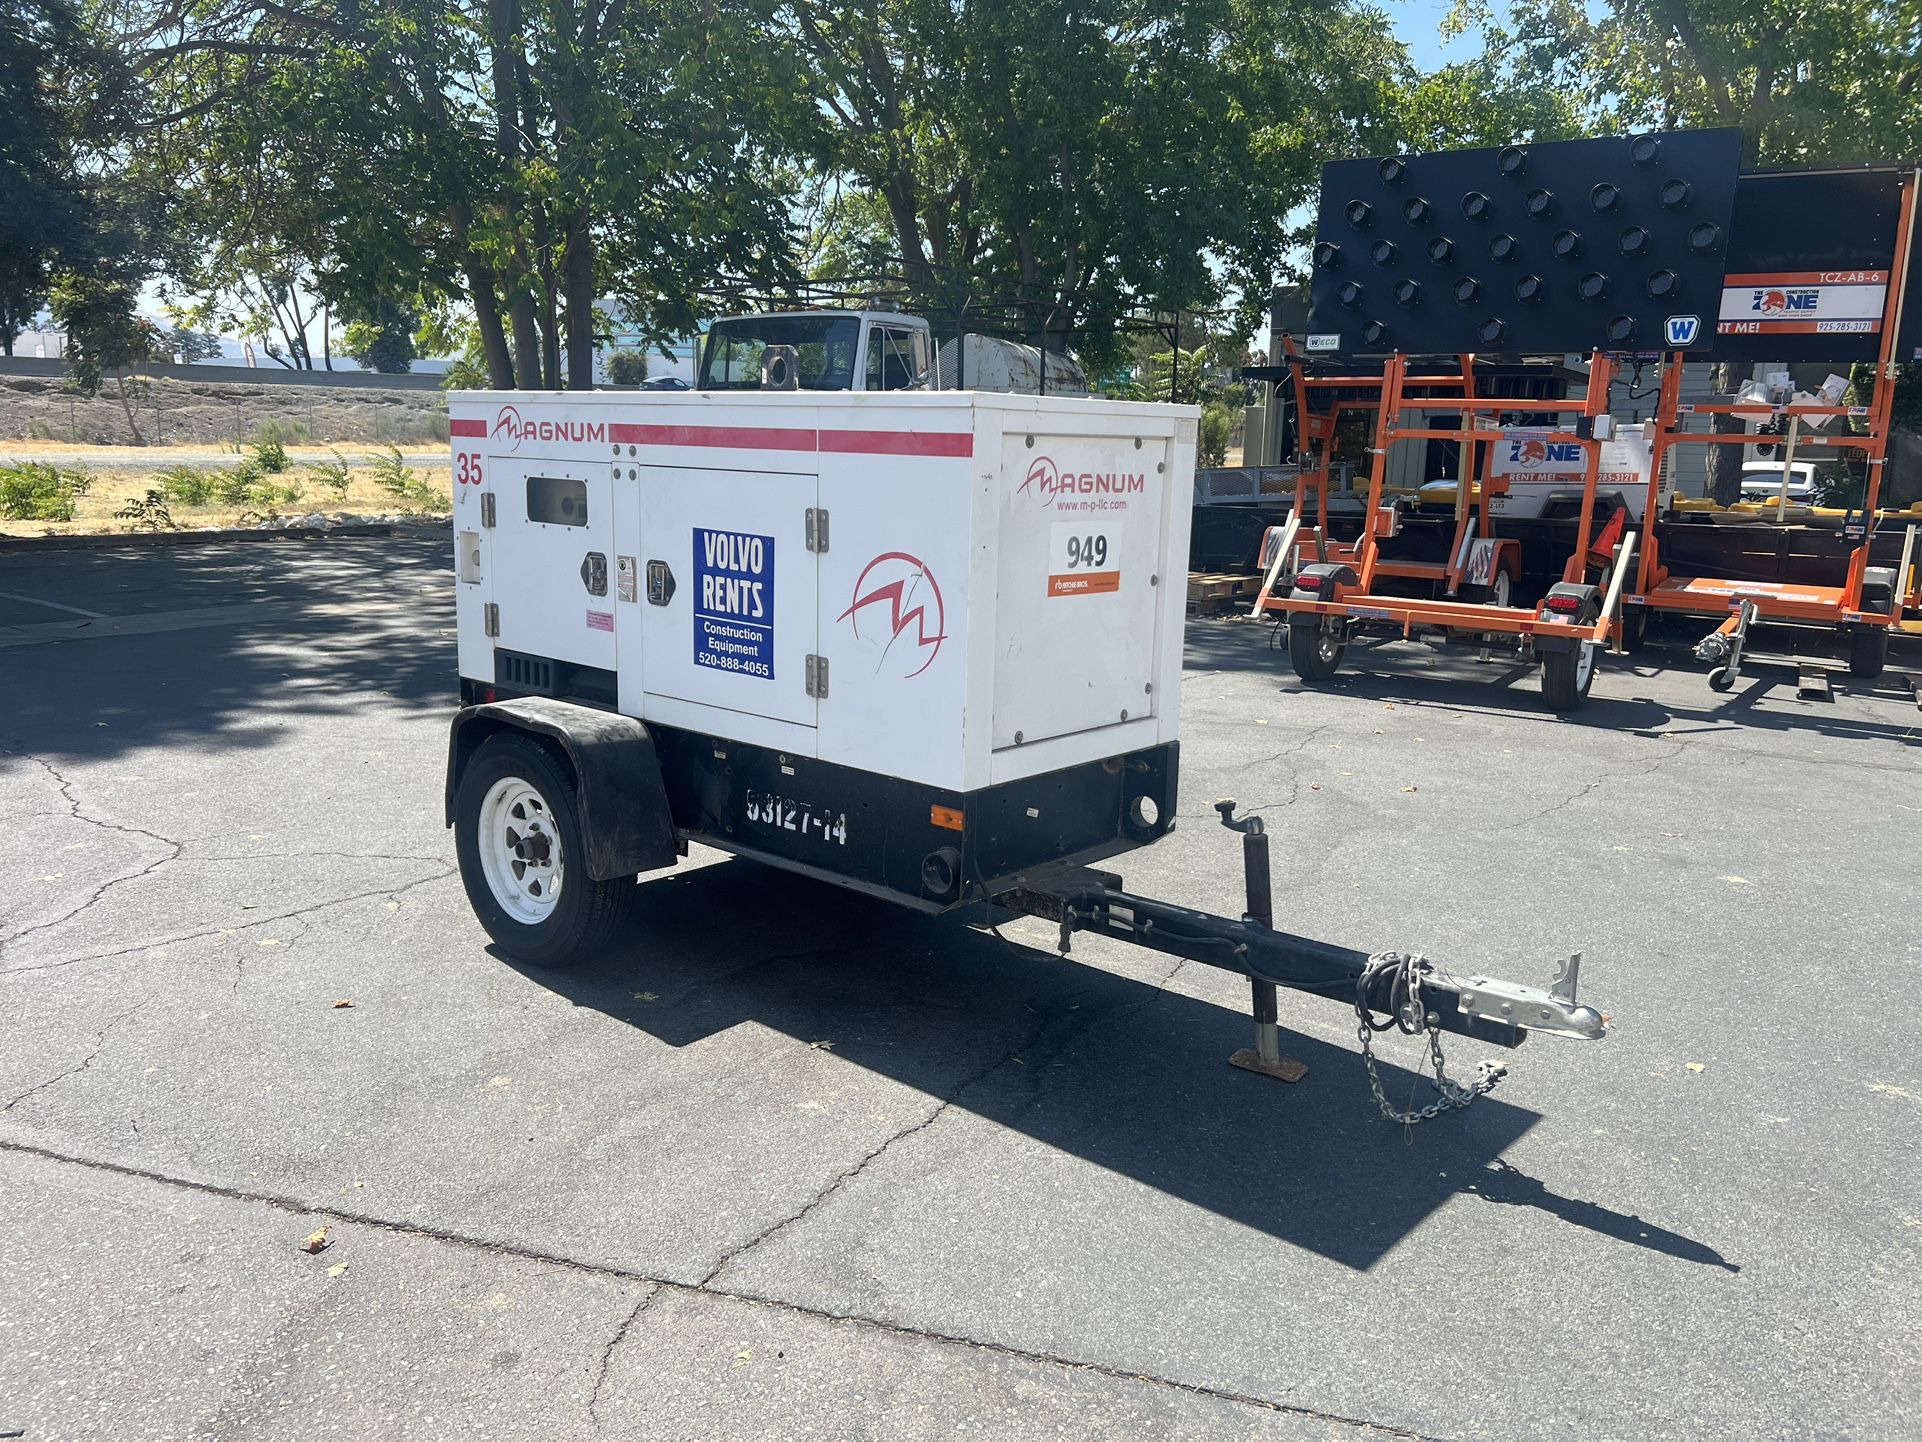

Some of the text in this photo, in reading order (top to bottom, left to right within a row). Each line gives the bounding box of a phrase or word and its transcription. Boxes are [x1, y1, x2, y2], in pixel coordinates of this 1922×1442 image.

[1819, 272, 1879, 283] TCZ-AB-6
[1671, 321, 1694, 340] W
[1716, 322, 1872, 334] NT ME! 925-285-3121
[490, 405, 605, 452] MAGNUM
[457, 452, 483, 485] 35
[1509, 473, 1535, 481] RENT
[1537, 473, 1556, 481] ME!
[1017, 455, 1144, 508] MAGNUM
[1056, 499, 1127, 512] www.m-p-llc.com
[703, 531, 764, 575] VOLVO
[1066, 534, 1108, 569] 949
[702, 574, 764, 618] RENTS
[703, 621, 763, 642] Construction
[708, 637, 759, 656] Equipment
[698, 652, 769, 677] 520-888-4055
